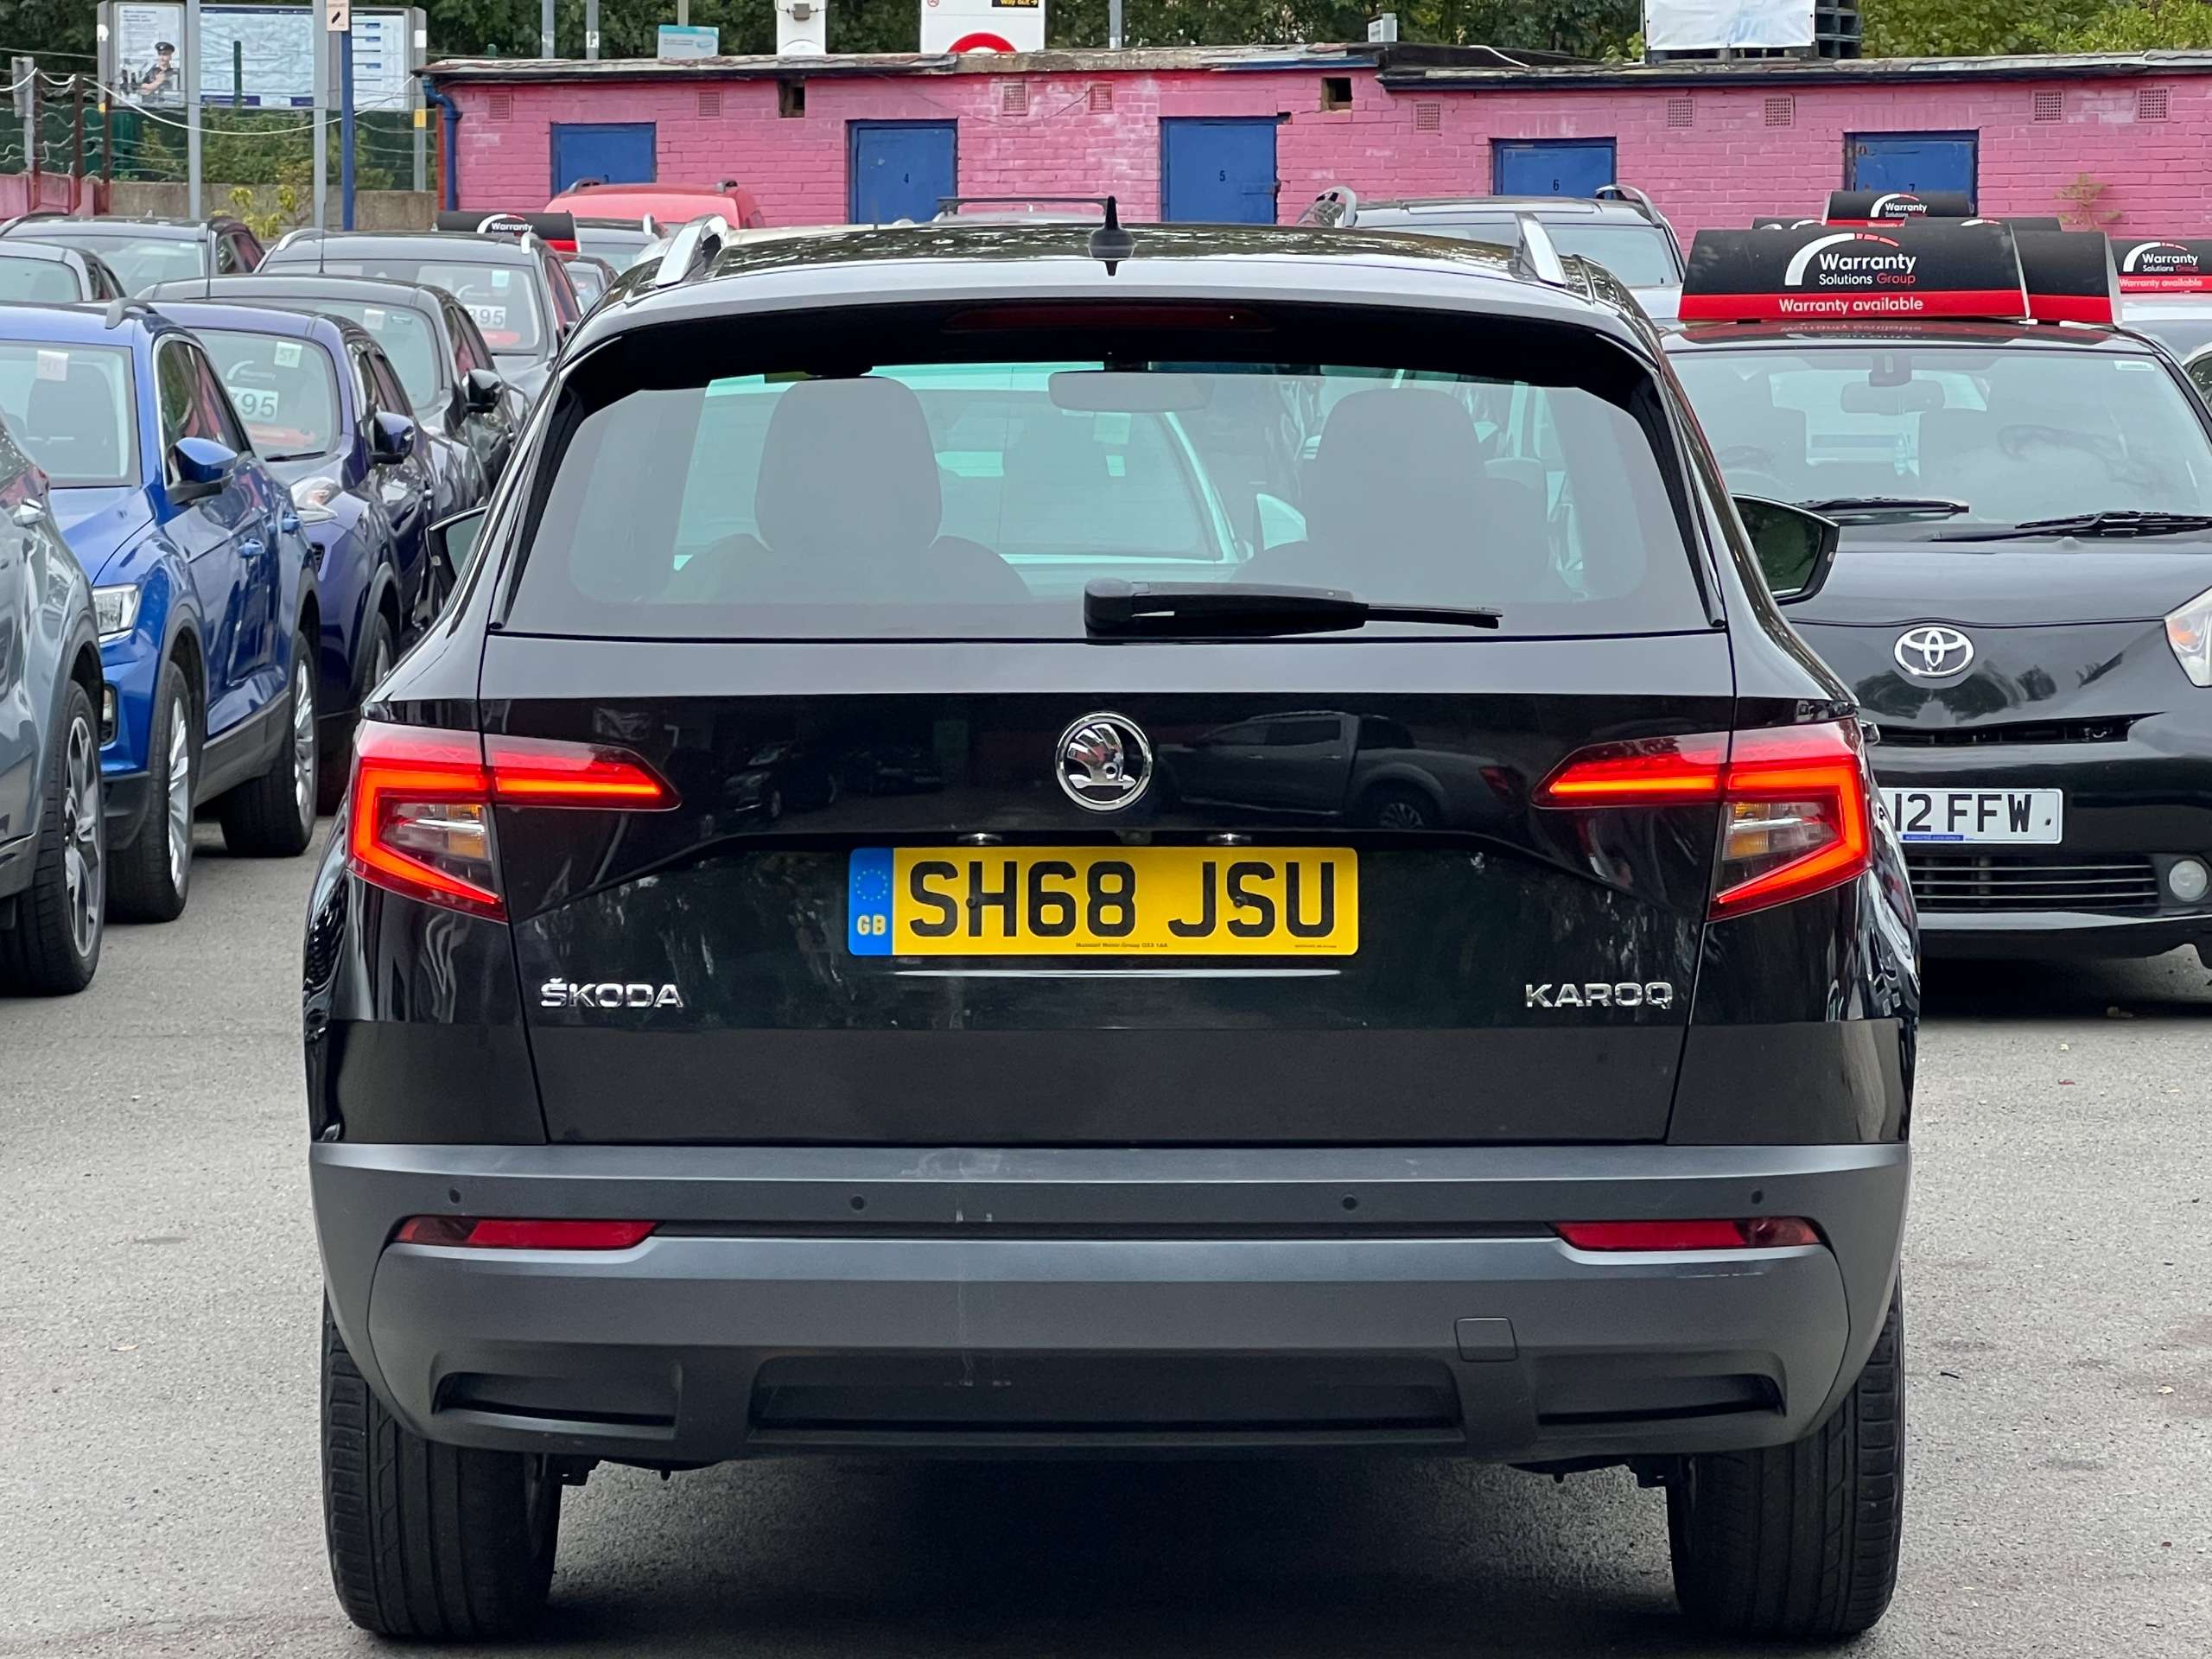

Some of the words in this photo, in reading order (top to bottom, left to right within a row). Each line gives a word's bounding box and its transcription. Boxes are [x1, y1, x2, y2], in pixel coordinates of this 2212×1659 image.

[1219, 170, 1225, 181] 5
[1553, 179, 1559, 191] 6
[1909, 183, 1915, 192] 7
[1885, 202, 1927, 213] Warranty
[491, 222, 532, 232] Warranty
[1819, 253, 1916, 274] Warranty
[2142, 253, 2198, 266] Warranty
[1819, 273, 1872, 285] Solutions
[1876, 272, 1916, 285] Group
[2120, 279, 2159, 289] Warranty
[2161, 277, 2202, 287] available
[1779, 298, 1849, 315] Warranty
[1853, 297, 1923, 310] available
[1948, 793, 2032, 833] FFW
[909, 861, 1136, 938] SH68
[1167, 861, 1335, 938] JSU
[856, 914, 887, 936] GB
[540, 977, 684, 1008] ŠKODA
[1525, 982, 1674, 1009] KAROQ
